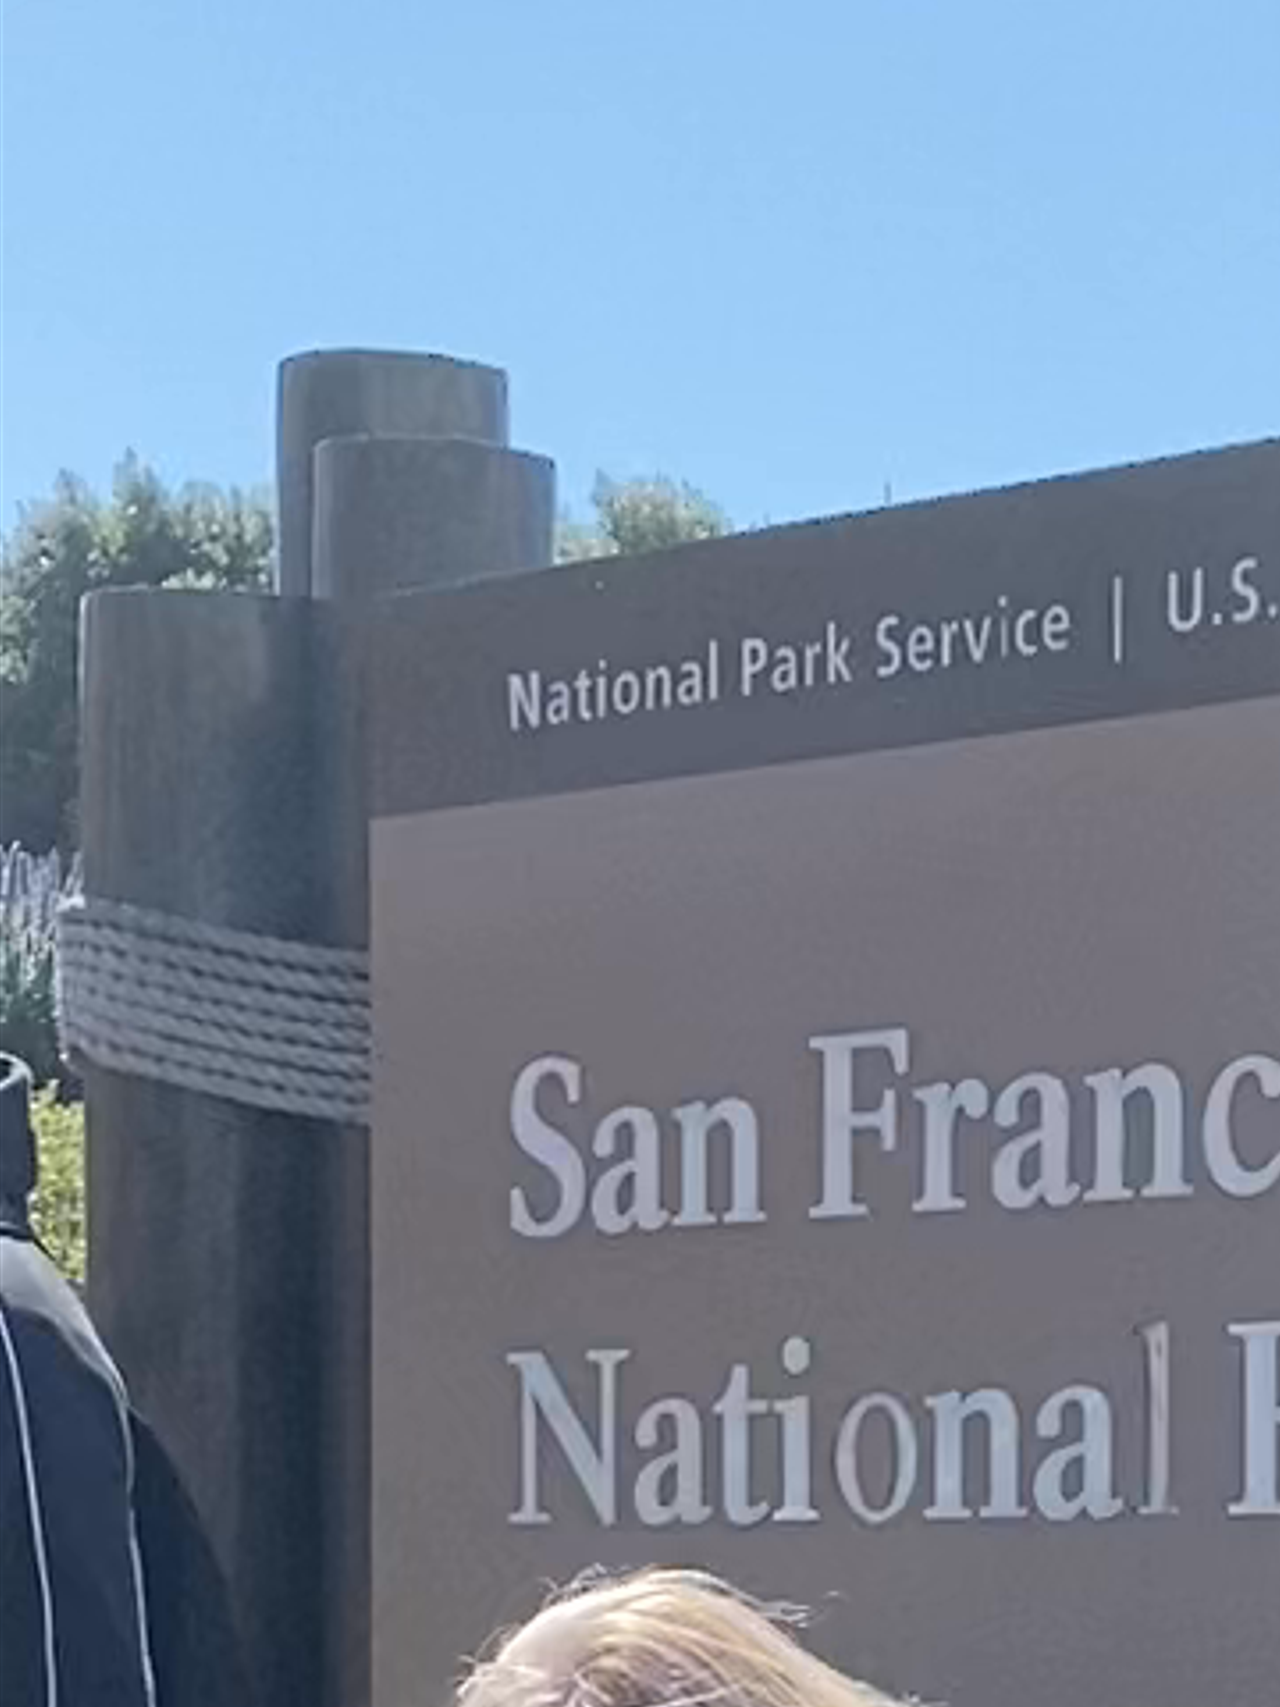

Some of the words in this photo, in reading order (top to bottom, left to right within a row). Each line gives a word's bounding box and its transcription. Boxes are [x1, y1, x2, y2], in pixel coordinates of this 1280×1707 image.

[507, 639, 719, 731] National
[741, 620, 853, 697] Park
[875, 595, 1071, 678] Service
[1167, 557, 1278, 632] U.S.
[509, 1055, 767, 1237] San
[506, 1321, 1180, 1526] National
